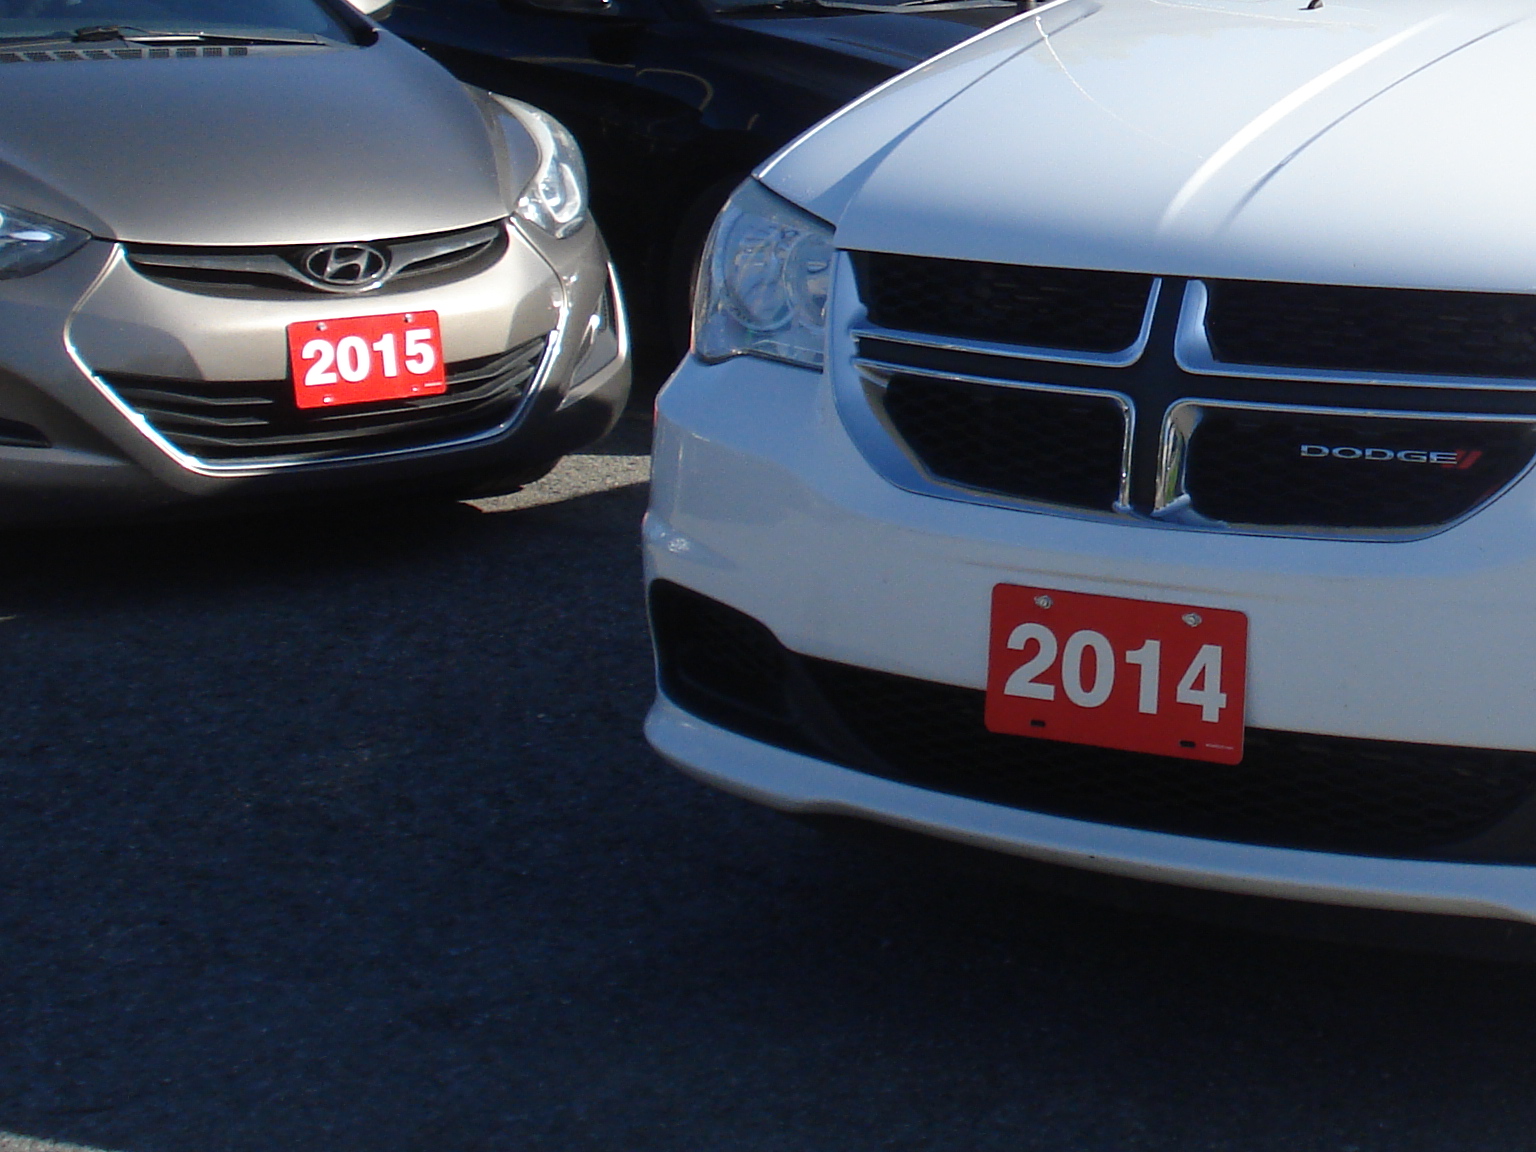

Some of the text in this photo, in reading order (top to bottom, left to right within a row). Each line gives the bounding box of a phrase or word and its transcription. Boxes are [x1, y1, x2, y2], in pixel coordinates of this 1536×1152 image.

[302, 328, 435, 386] 2015
[1299, 443, 1459, 465] DODGE
[1003, 621, 1228, 723] 2014
